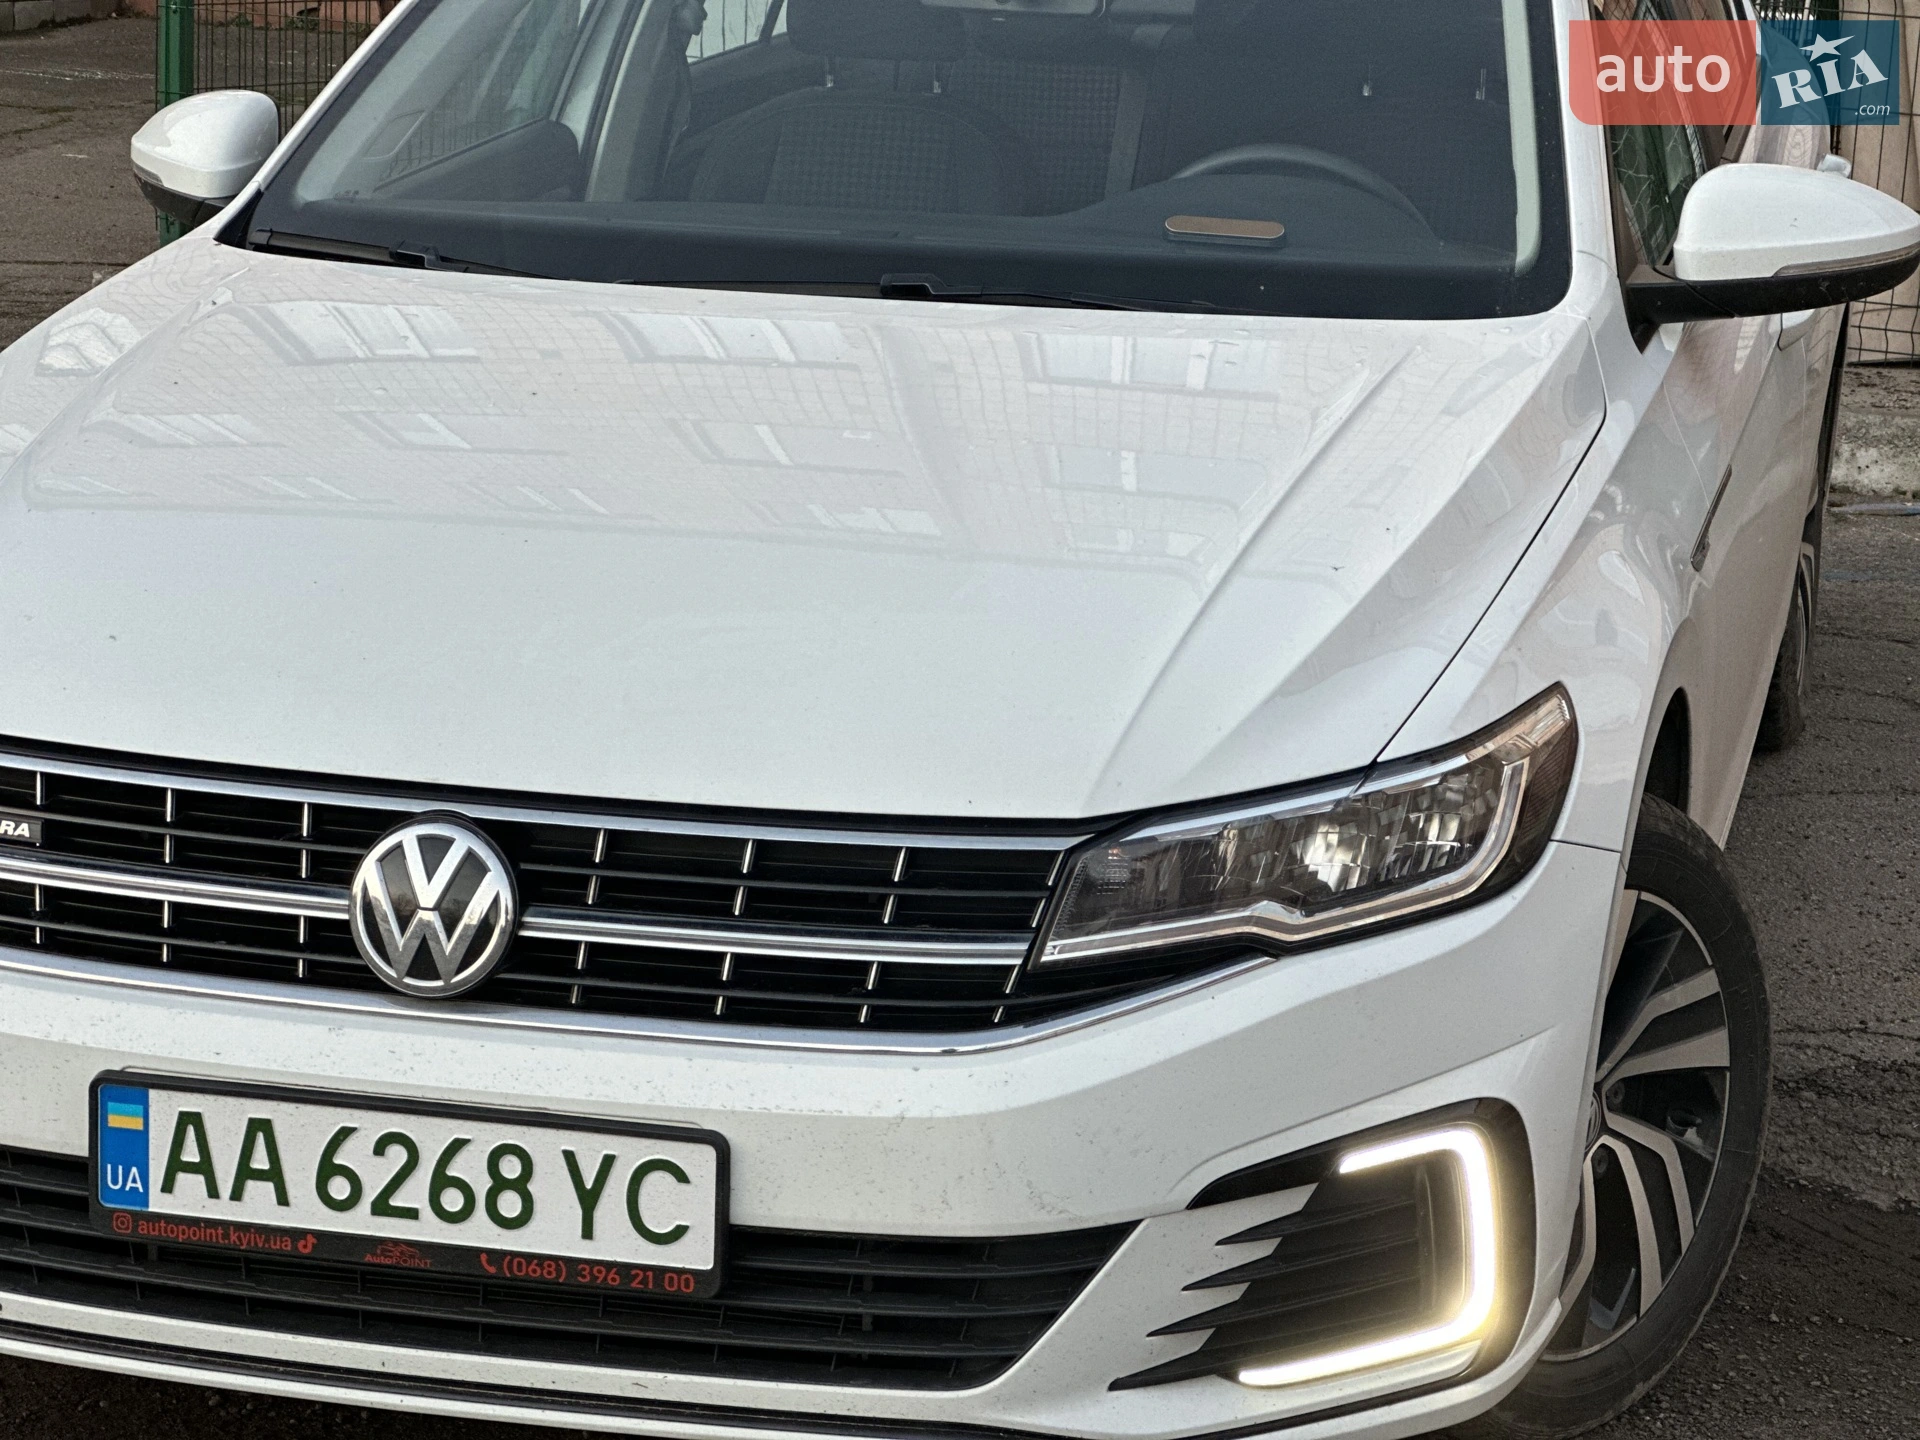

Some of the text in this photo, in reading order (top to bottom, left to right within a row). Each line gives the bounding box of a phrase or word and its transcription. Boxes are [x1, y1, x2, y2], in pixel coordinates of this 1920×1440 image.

[106, 1164, 144, 1193] UA
[160, 1110, 691, 1245] AA 6268 YC
[137, 1219, 292, 1250] autopoint.kyiv.ua
[363, 1254, 432, 1268] AutoPOINT
[502, 1255, 695, 1293] (068) 396 21 00
